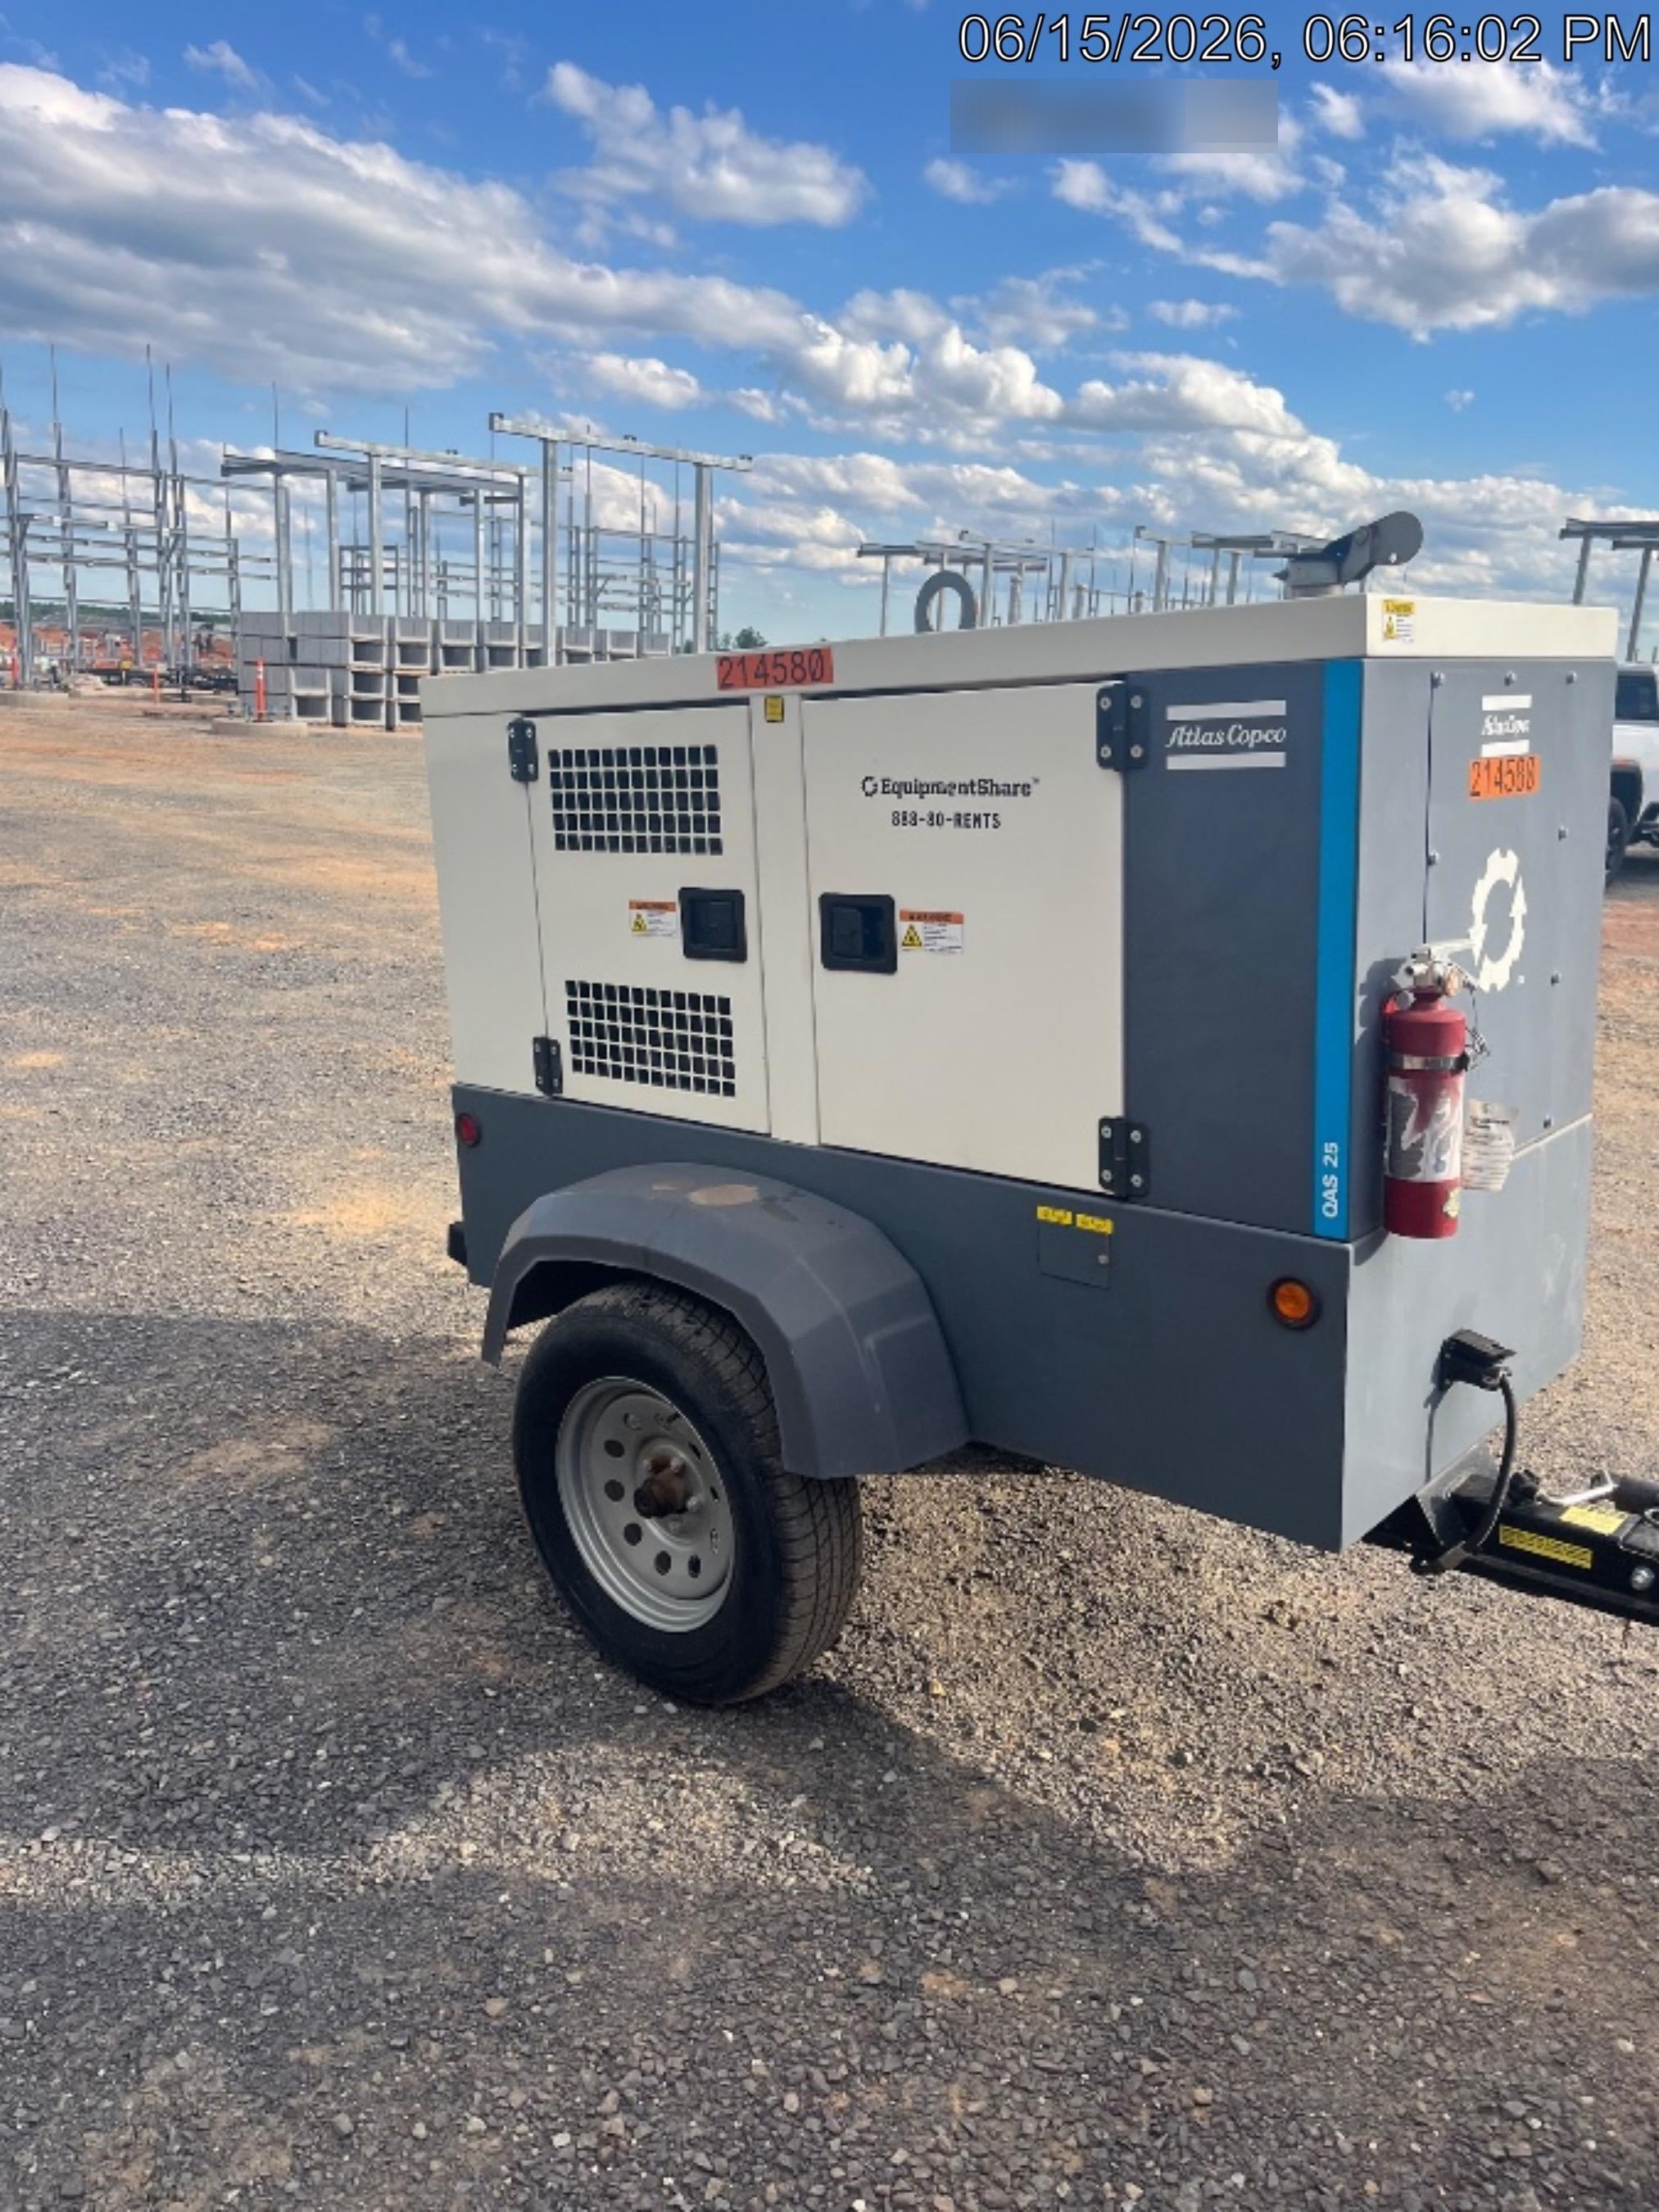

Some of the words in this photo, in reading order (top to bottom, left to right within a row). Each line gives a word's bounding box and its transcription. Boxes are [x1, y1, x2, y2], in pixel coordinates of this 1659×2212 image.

[718, 648, 825, 689] 214580
[1164, 724, 1226, 748] Atlas
[1226, 723, 1287, 749] Copco
[880, 777, 1032, 800] EquipmentShare
[891, 810, 1002, 829] 888-80-RENTS
[1321, 1141, 1339, 1168] 25
[1321, 1173, 1339, 1219] QAS
